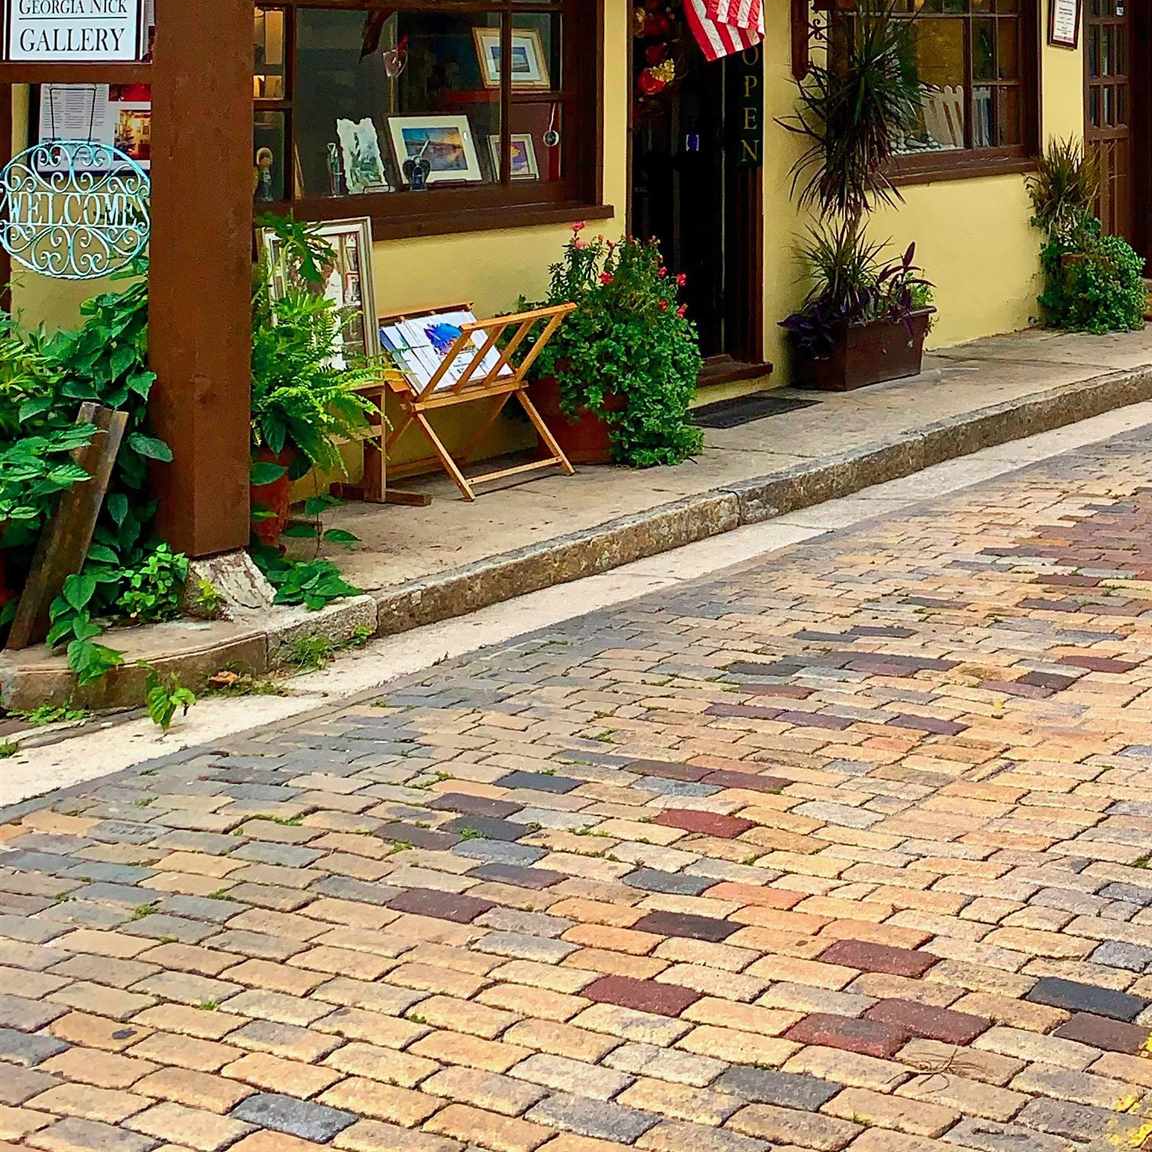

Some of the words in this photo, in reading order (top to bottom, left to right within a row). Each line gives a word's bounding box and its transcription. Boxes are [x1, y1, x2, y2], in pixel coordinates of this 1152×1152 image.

[19, 26, 125, 53] GALLERY
[741, 46, 761, 163] OPEN
[7, 191, 139, 228] WELCOME
